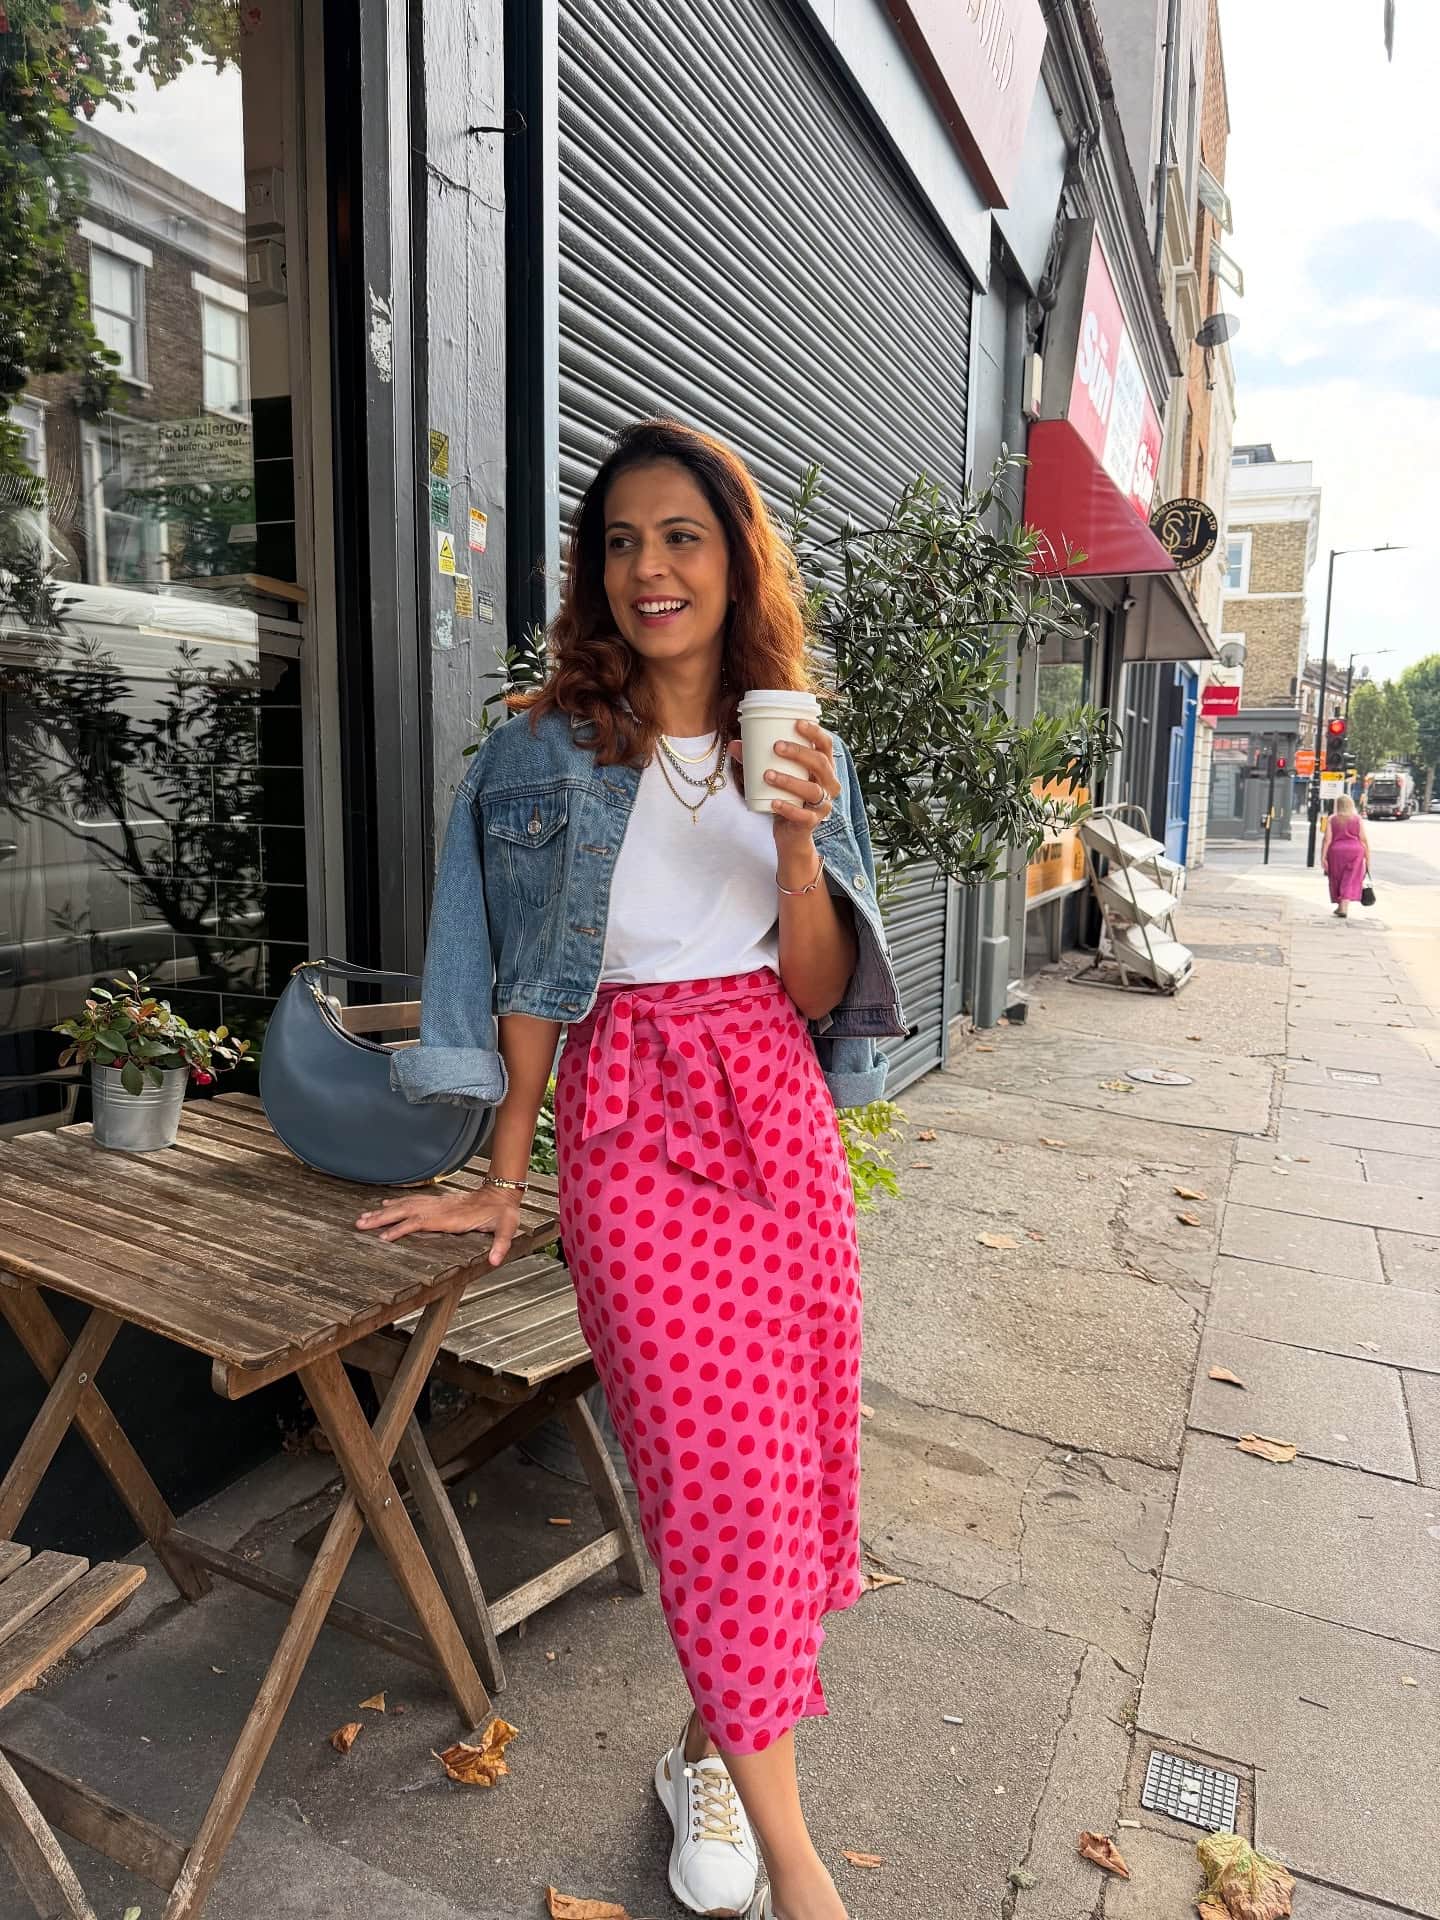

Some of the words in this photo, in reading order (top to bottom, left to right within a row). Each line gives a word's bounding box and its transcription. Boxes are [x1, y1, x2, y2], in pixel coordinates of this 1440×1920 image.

[158, 424, 190, 440] Food
[209, 441, 225, 451] you
[1207, 515, 1217, 531] LTD
